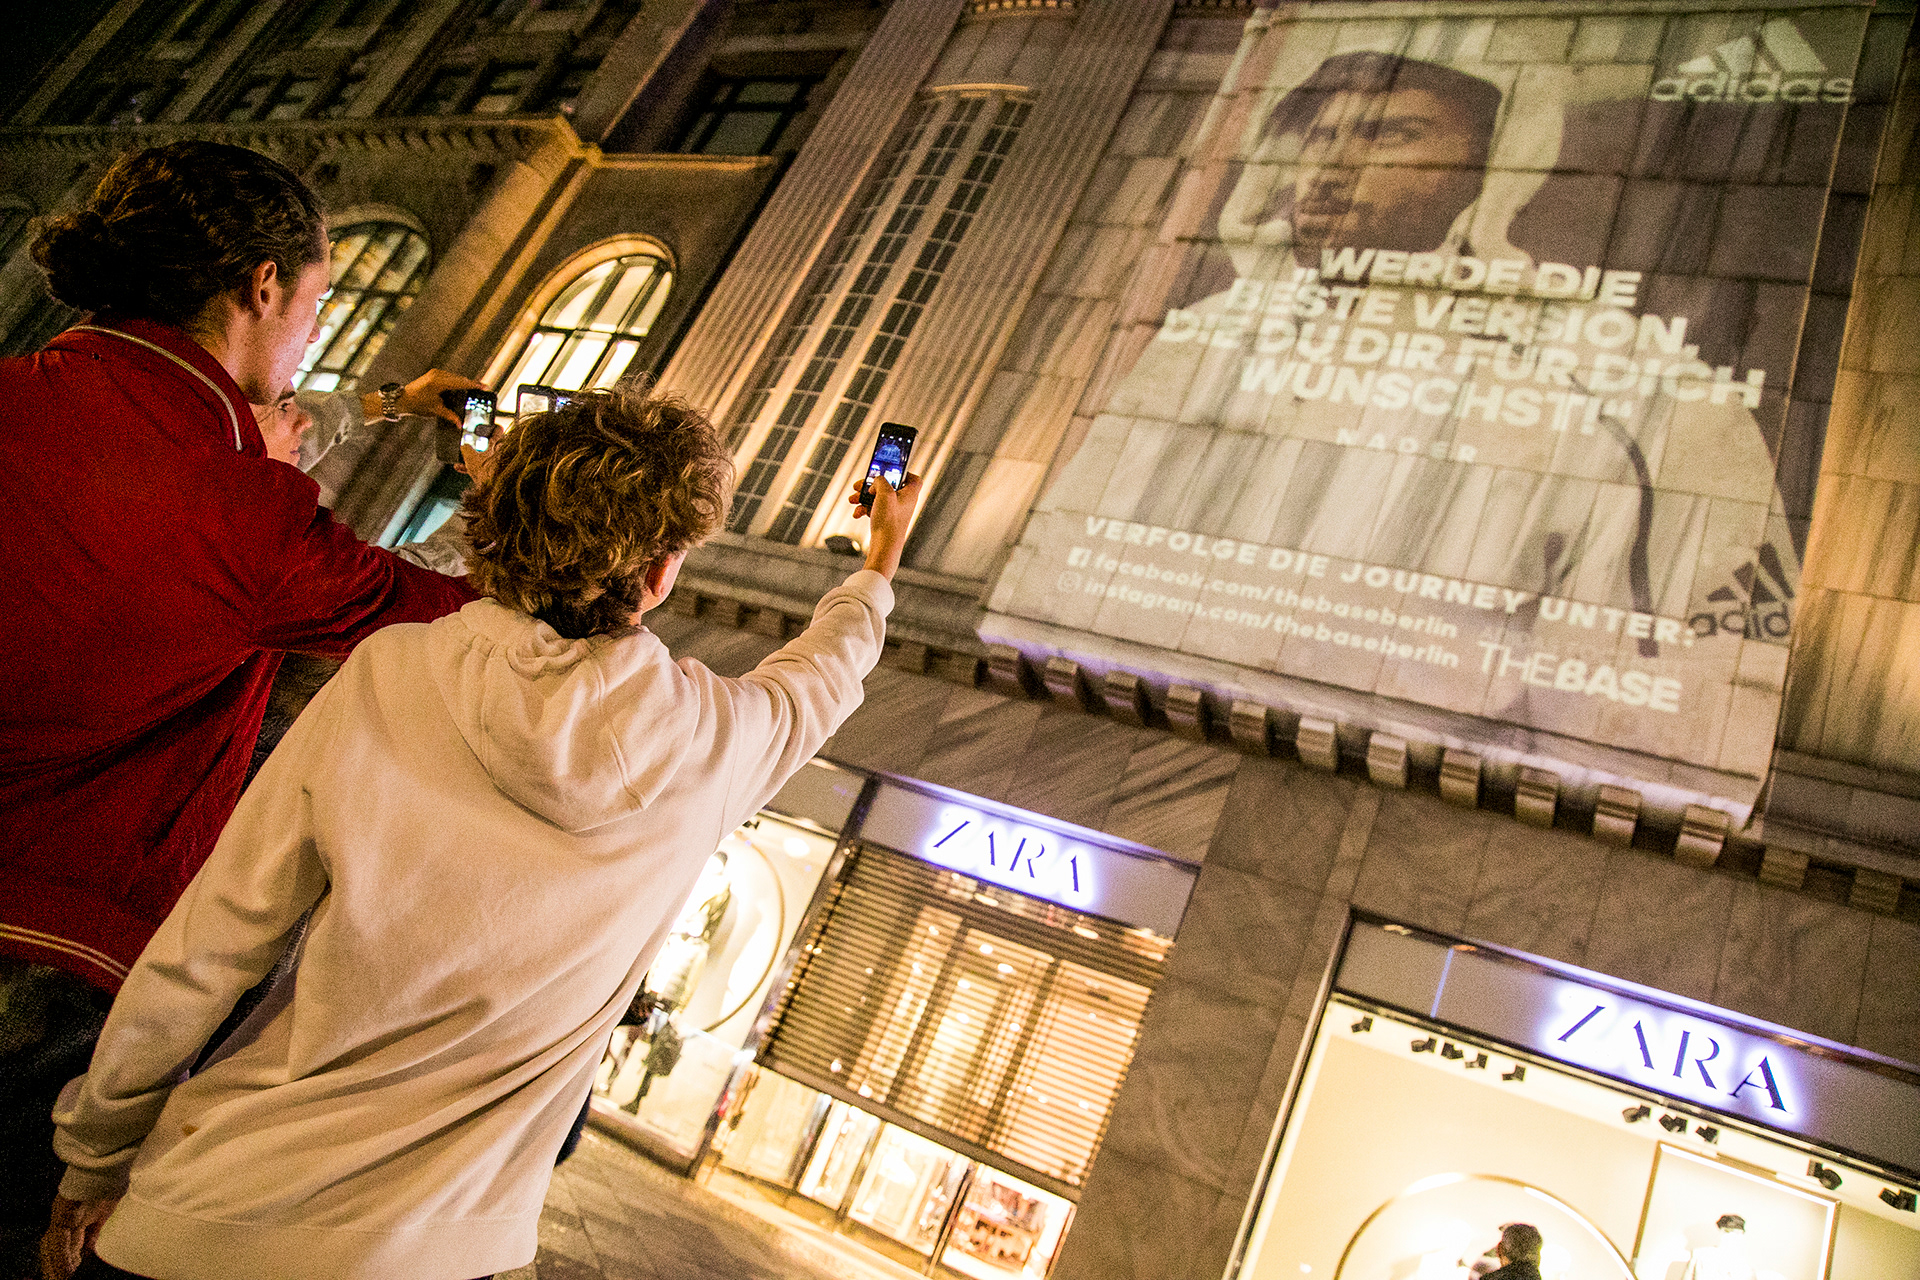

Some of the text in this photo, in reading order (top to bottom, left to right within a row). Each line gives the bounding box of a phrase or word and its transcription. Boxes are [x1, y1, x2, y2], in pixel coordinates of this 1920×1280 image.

[1651, 71, 1855, 104] adidas
[1224, 277, 1700, 360] BESTE VERSION,
[1535, 261, 1643, 308] DIE
[1157, 308, 1248, 349] DIE
[1255, 317, 1341, 356] DU
[1342, 326, 1446, 371] DIR
[1588, 352, 1767, 410] DICH
[1084, 576, 1460, 669] instagram.com/thebaseberlin
[1085, 515, 1696, 648] VERFOLGE DIE JOURNEY UNTER:
[1093, 552, 1458, 639] facebook.com/thebaseberlin
[930, 815, 1086, 898] ZARA
[1556, 1004, 1794, 1116] ZARA
